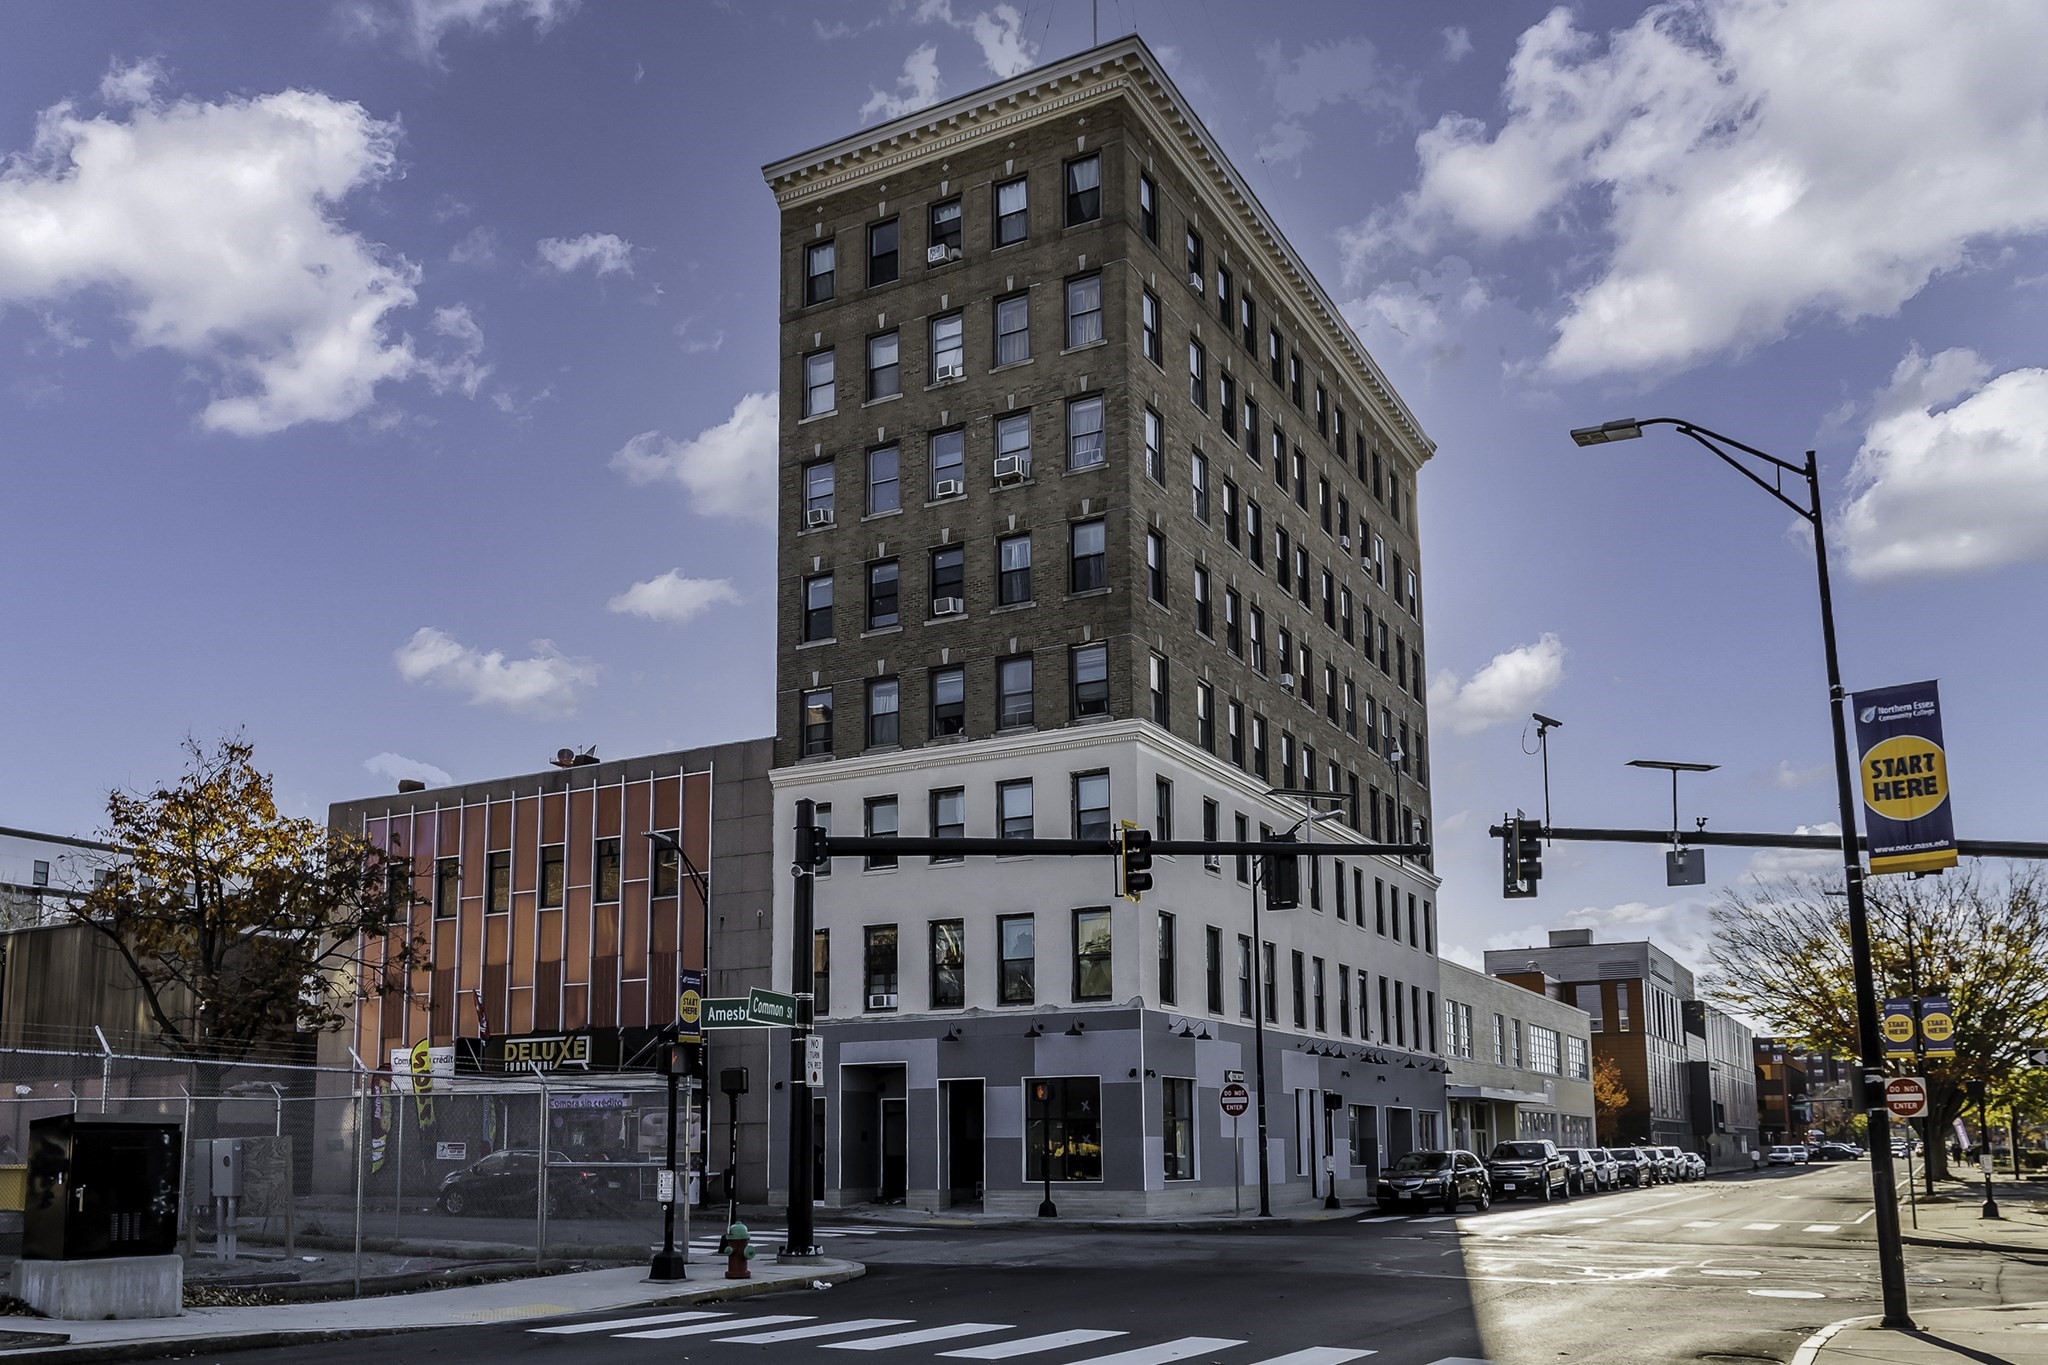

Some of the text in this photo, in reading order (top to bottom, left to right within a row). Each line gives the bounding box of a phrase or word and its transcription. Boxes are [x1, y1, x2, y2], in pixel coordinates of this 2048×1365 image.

[1878, 701, 1935, 714] Northern Essex
[1878, 712, 1912, 721] Community
[1870, 752, 1936, 779] START
[1872, 775, 1938, 802] HERE
[1874, 840, 1949, 854] www.necc.mass.edu
[683, 998, 698, 1007] START
[753, 996, 793, 1019] Common St
[683, 1006, 698, 1015] HERE
[811, 1039, 820, 1049] NO
[504, 1036, 585, 1070] DELUXE
[810, 1050, 820, 1059] TURN
[432, 1054, 454, 1065] crédit
[808, 1061, 822, 1069] ON RED
[1903, 1085, 1919, 1093] NOT
[550, 1098, 623, 1109] Compra sin crédito
[1893, 1102, 1918, 1110] ENTER
